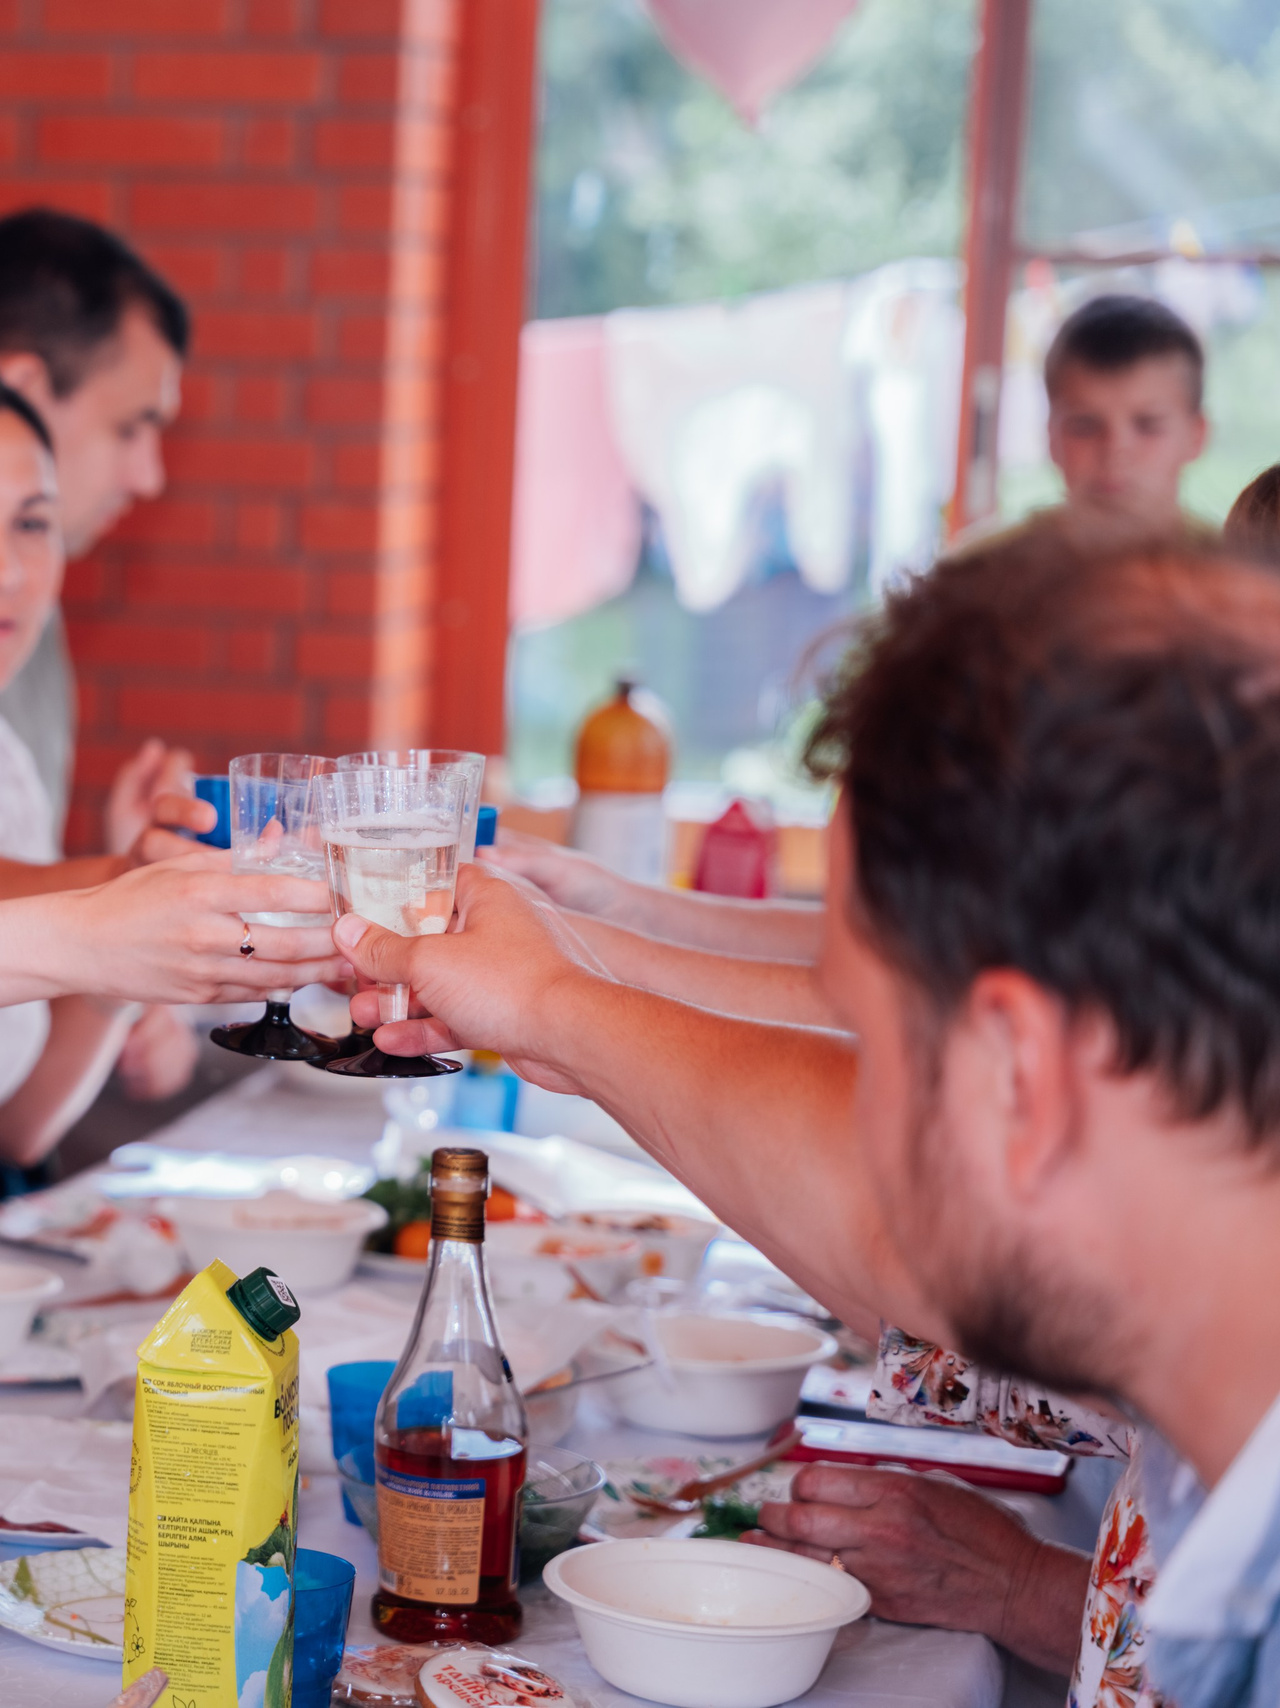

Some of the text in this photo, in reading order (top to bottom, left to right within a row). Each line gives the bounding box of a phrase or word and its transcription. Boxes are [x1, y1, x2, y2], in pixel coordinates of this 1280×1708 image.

[152, 1379, 165, 1387] СОК
[167, 1381, 201, 1390] ЯБЛОЧНЫЙ
[202, 1384, 265, 1395] ВОССТАНОВЛЕННЫЙ
[168, 1515, 188, 1524] ҚАЙТА
[189, 1518, 221, 1526] ҚАЛПЫНА
[158, 1523, 197, 1533] КЕЛТІРІЛГЕН
[198, 1527, 220, 1536] АШЫҚ
[158, 1532, 187, 1541] БЕРІЛГЕН
[158, 1540, 190, 1549] ШЫРЫНЫ
